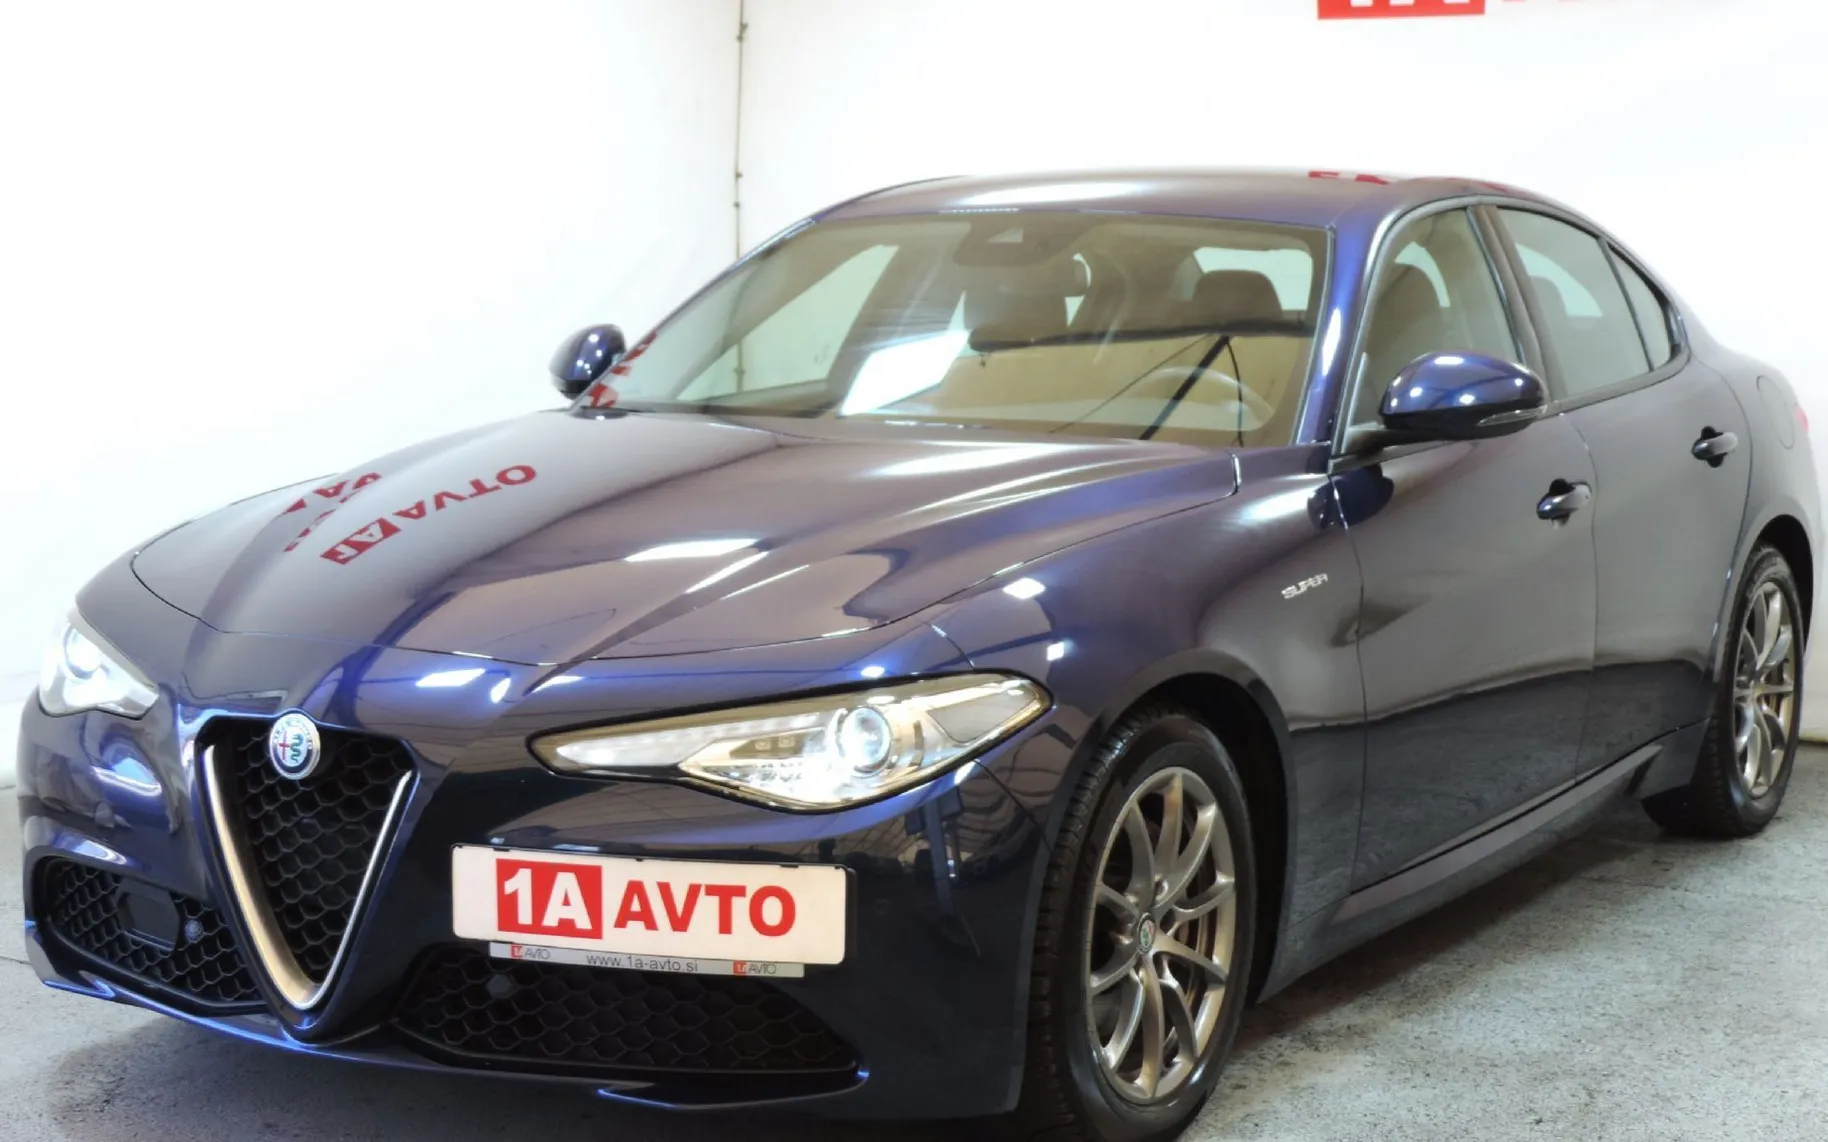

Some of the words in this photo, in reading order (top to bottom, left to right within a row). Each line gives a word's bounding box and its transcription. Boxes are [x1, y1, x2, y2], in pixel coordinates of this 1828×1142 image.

[503, 868, 593, 930] 1A
[614, 880, 796, 937] AVTO
[586, 954, 698, 973] www.1a-avto.si
